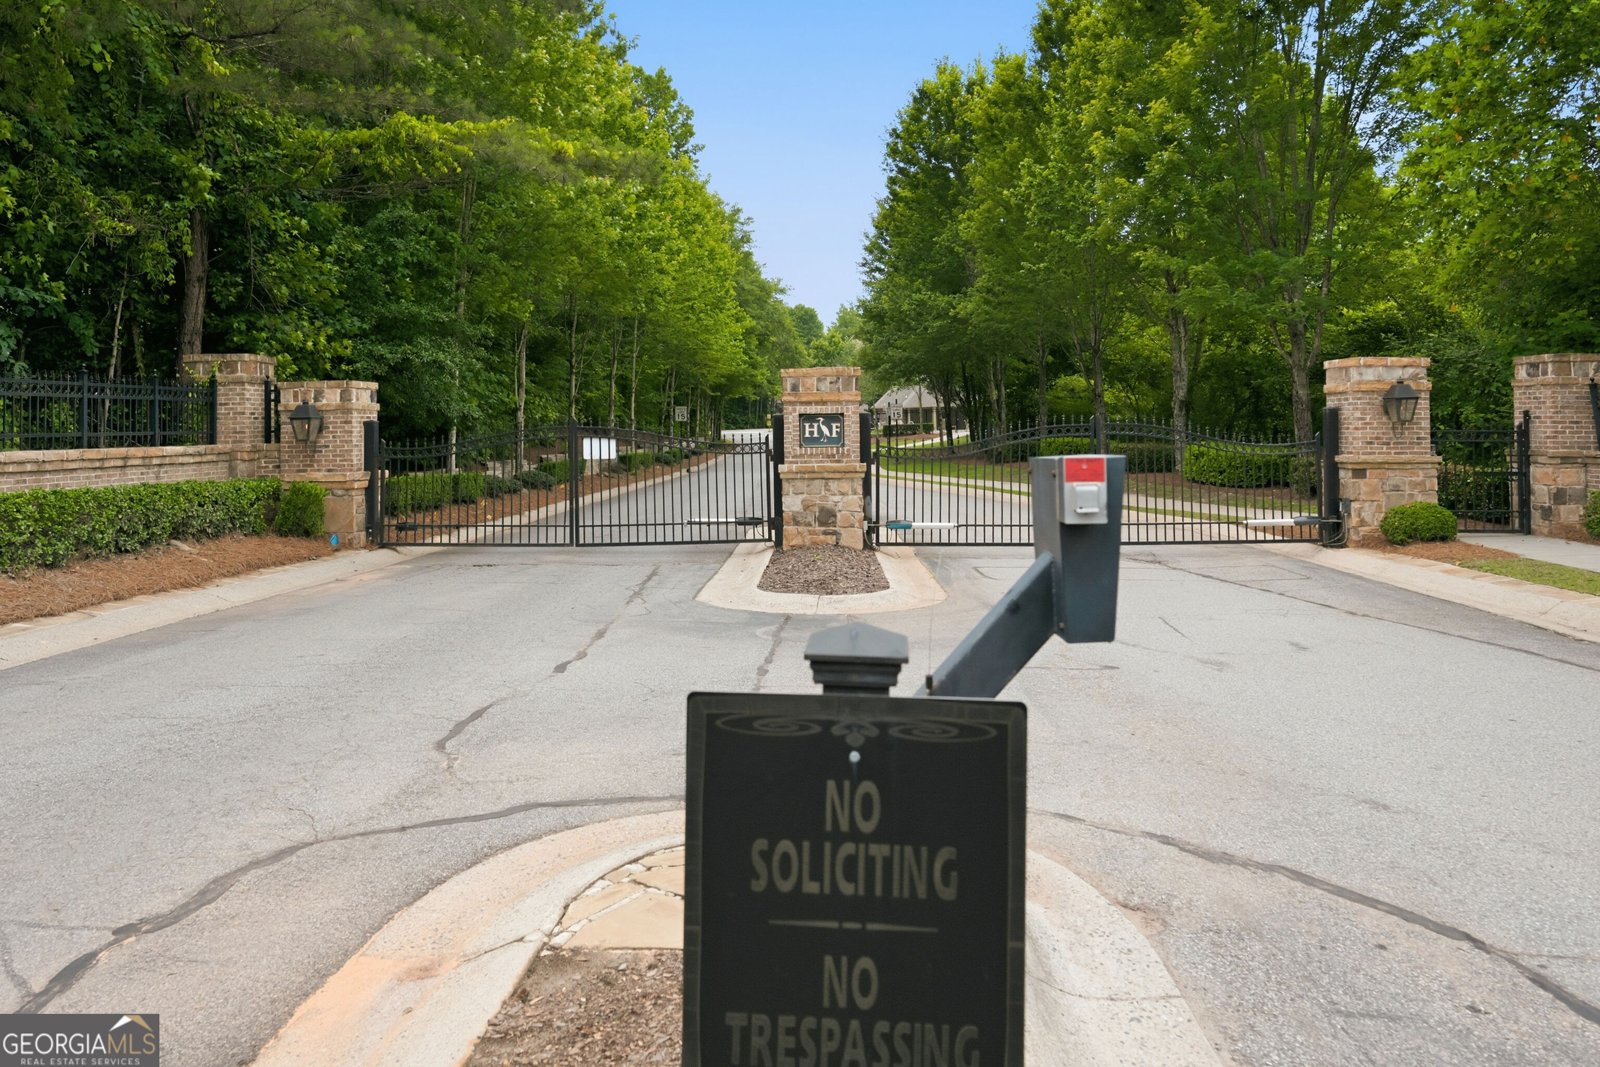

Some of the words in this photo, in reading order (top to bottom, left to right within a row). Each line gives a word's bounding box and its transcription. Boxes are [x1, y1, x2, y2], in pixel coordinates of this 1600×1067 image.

[825, 779, 881, 834] NO
[750, 838, 958, 901] SOLICITING
[822, 955, 878, 1010] NO
[724, 1012, 980, 1067] TRESPASSING
